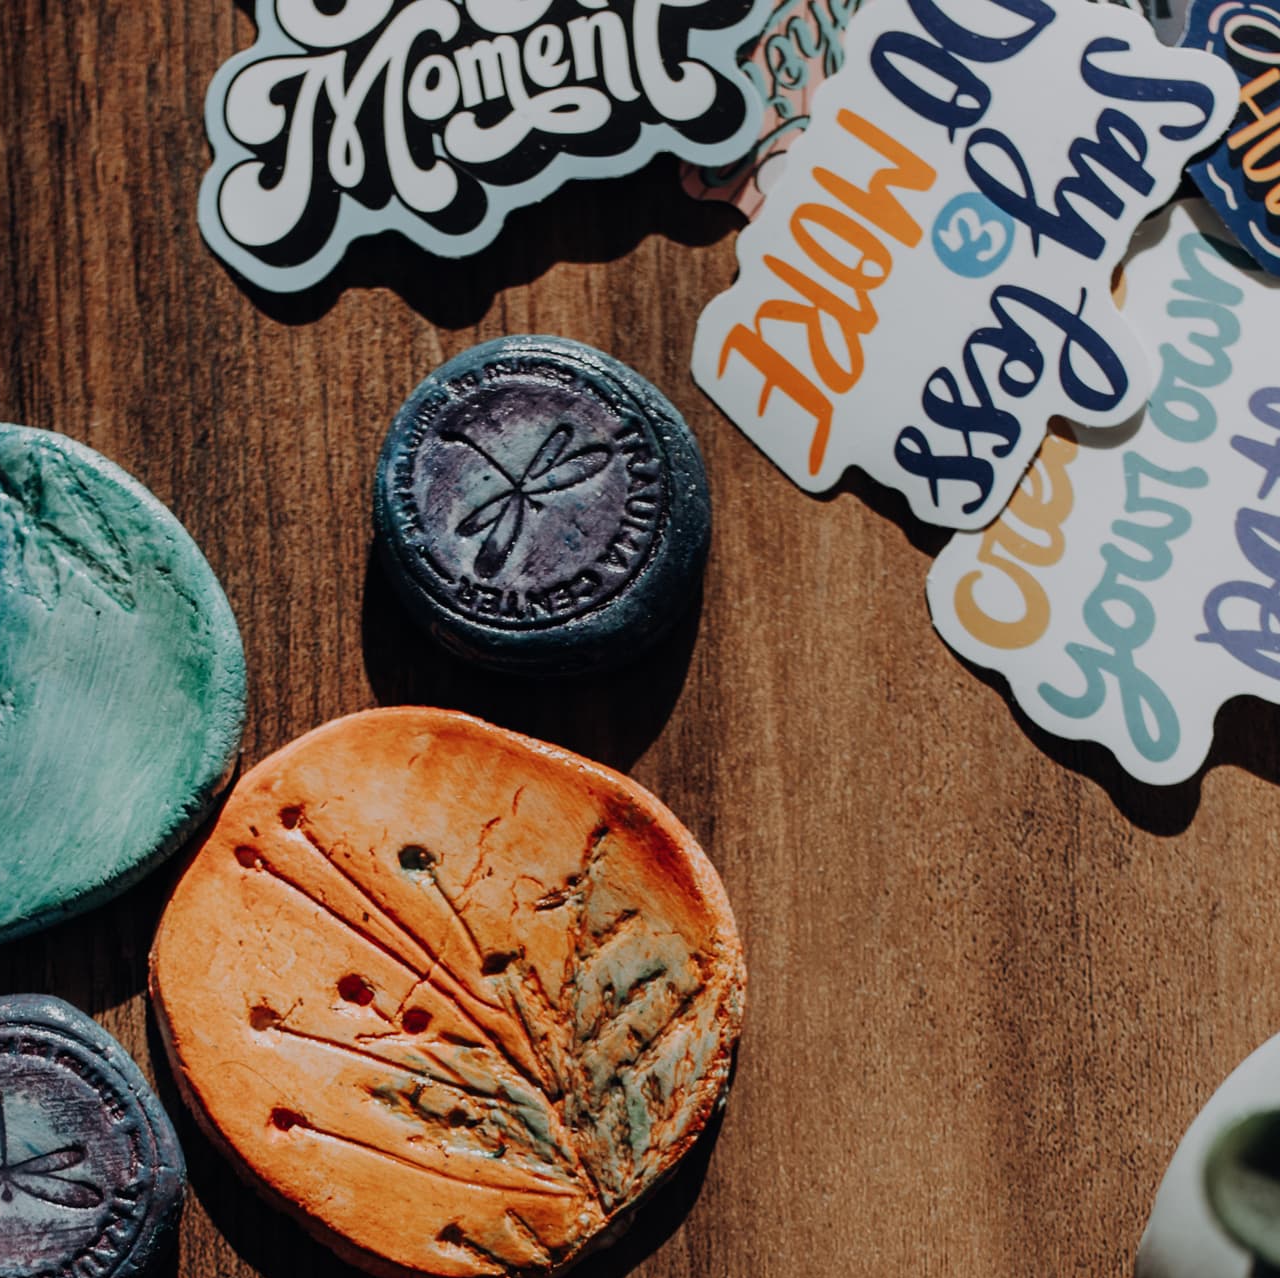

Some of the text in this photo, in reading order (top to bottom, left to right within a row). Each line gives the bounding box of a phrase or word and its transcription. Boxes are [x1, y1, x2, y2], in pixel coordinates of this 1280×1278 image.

[219, 0, 718, 247] Moment
[716, 107, 938, 477] MORE
[893, 36, 1217, 516] Say less
[457, 567, 604, 620] CENTER
[1037, 231, 1245, 763] your own
